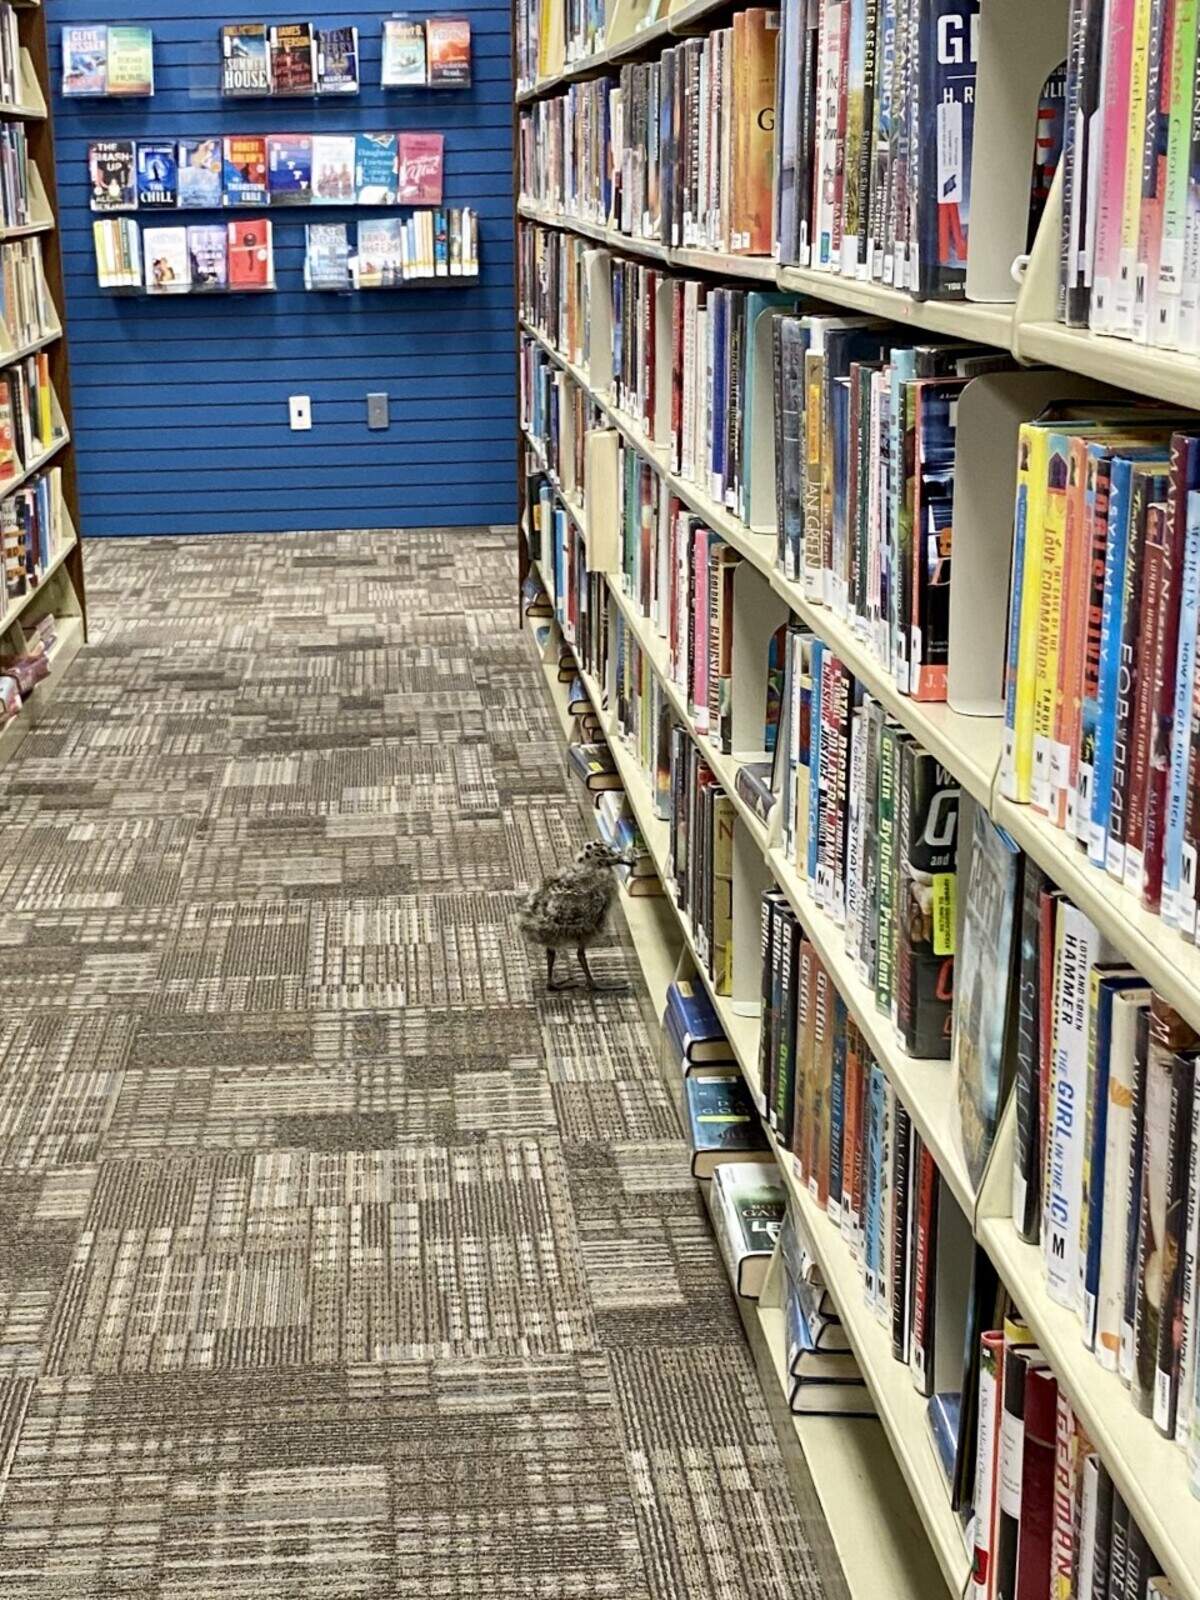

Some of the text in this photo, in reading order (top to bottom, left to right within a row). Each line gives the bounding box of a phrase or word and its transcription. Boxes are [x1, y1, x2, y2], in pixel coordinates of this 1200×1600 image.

[225, 70, 267, 88] HOUSE
[863, 30, 876, 88] SECRET
[882, 29, 896, 119] CLANCY
[97, 143, 118, 151] THE
[107, 163, 122, 172] UP
[861, 129, 870, 170] Shelley
[1063, 125, 1076, 203] CAPITOL
[140, 191, 174, 203] CHILL
[859, 176, 868, 223] Shepard
[1165, 209, 1176, 238] HA
[1130, 489, 1142, 553] Timothy
[1166, 447, 1179, 533] MARY
[805, 481, 820, 569] JANE GREEN
[1101, 482, 1119, 663] ASYMMETRY
[1148, 558, 1157, 604] SUMMER
[1186, 526, 1199, 609] MOHSIN
[1036, 528, 1058, 679] LOVE COMMANDOS
[1155, 579, 1170, 692] Nazareth
[709, 625, 720, 720] GANGSTERLAND
[819, 662, 833, 780] CHASING JUSTICE
[838, 676, 850, 800] FATAL DEGREE
[1110, 643, 1133, 836] FOR DEAD
[1171, 642, 1190, 828] HOW TO GET FILTHY RICH
[825, 726, 839, 870] COLLATERAL DAMA
[881, 737, 893, 799] Griffin
[1092, 725, 1102, 810] HALLIDAY
[1146, 789, 1157, 850] MAREK
[848, 823, 858, 911] STRAY SOU
[930, 853, 949, 867] and
[761, 902, 769, 957] Griffin
[878, 818, 892, 990] By Order President
[772, 914, 782, 970] Griffin
[782, 922, 792, 989] Griffin
[1078, 940, 1088, 993] LOTTE AND
[815, 970, 827, 1042] Griffin
[1062, 933, 1077, 1025] HAMMER
[1057, 1049, 1068, 1077] THE
[831, 1072, 842, 1176] NICOLA GRIFFITH
[1055, 1080, 1074, 1137] GIRL
[1129, 1055, 1140, 1157] AVAILABLE
[1052, 1161, 1063, 1188] THE
[1054, 1143, 1063, 1159] IN
[751, 1220, 781, 1232] LE
[1050, 1193, 1069, 1230] IC
[917, 1225, 926, 1294] MARTHA
[1052, 1234, 1065, 1259] M
[1184, 1252, 1194, 1305] DANIEL
[914, 1298, 923, 1345] GRIM
[1110, 1520, 1127, 1592] FORCE
